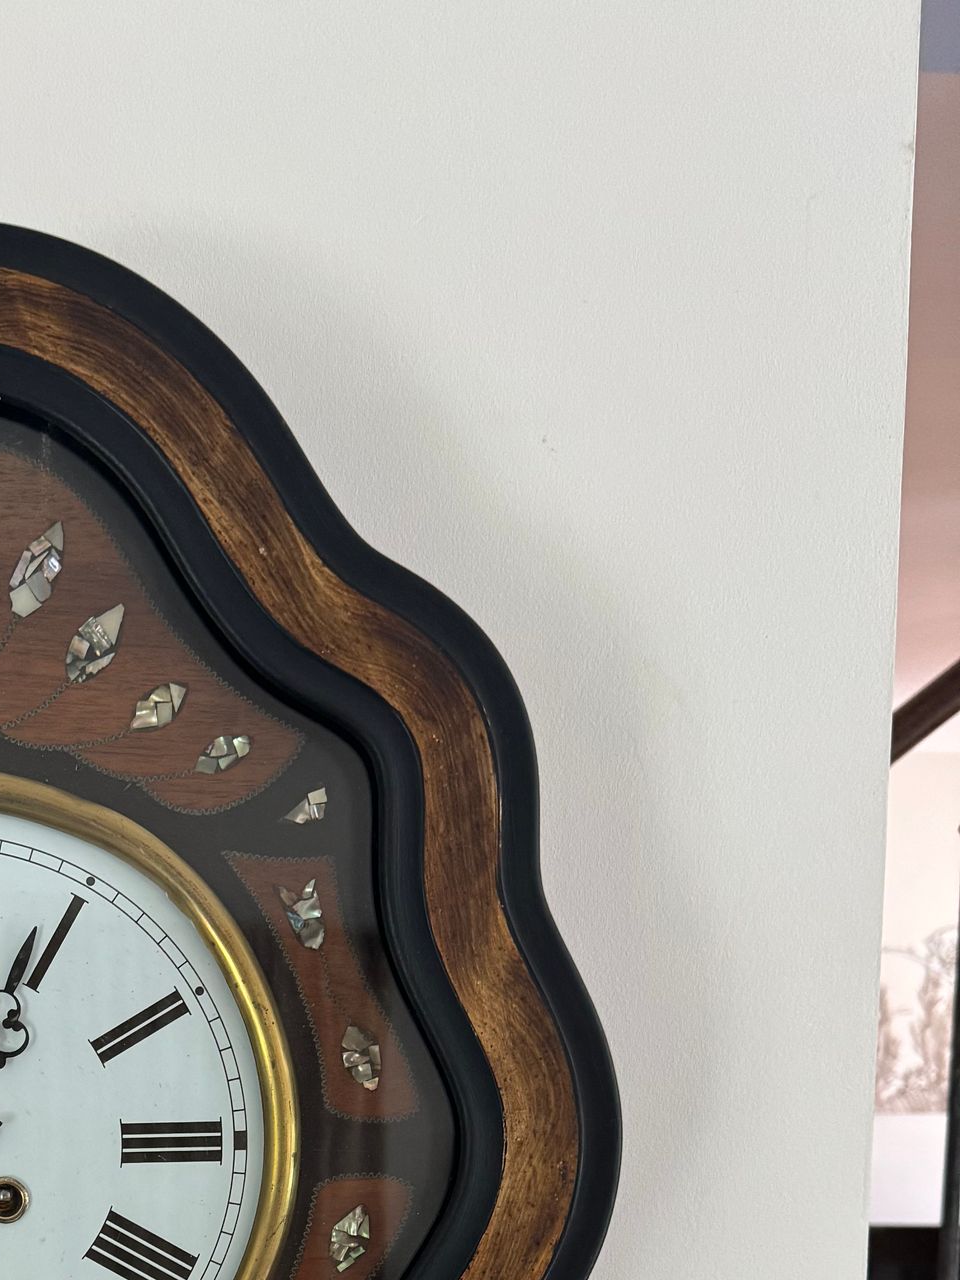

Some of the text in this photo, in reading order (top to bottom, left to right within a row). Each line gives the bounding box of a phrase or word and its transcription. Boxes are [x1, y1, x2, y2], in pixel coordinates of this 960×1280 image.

[22, 892, 89, 993] I
[88, 986, 192, 1068] II
[120, 1116, 223, 1168] III
